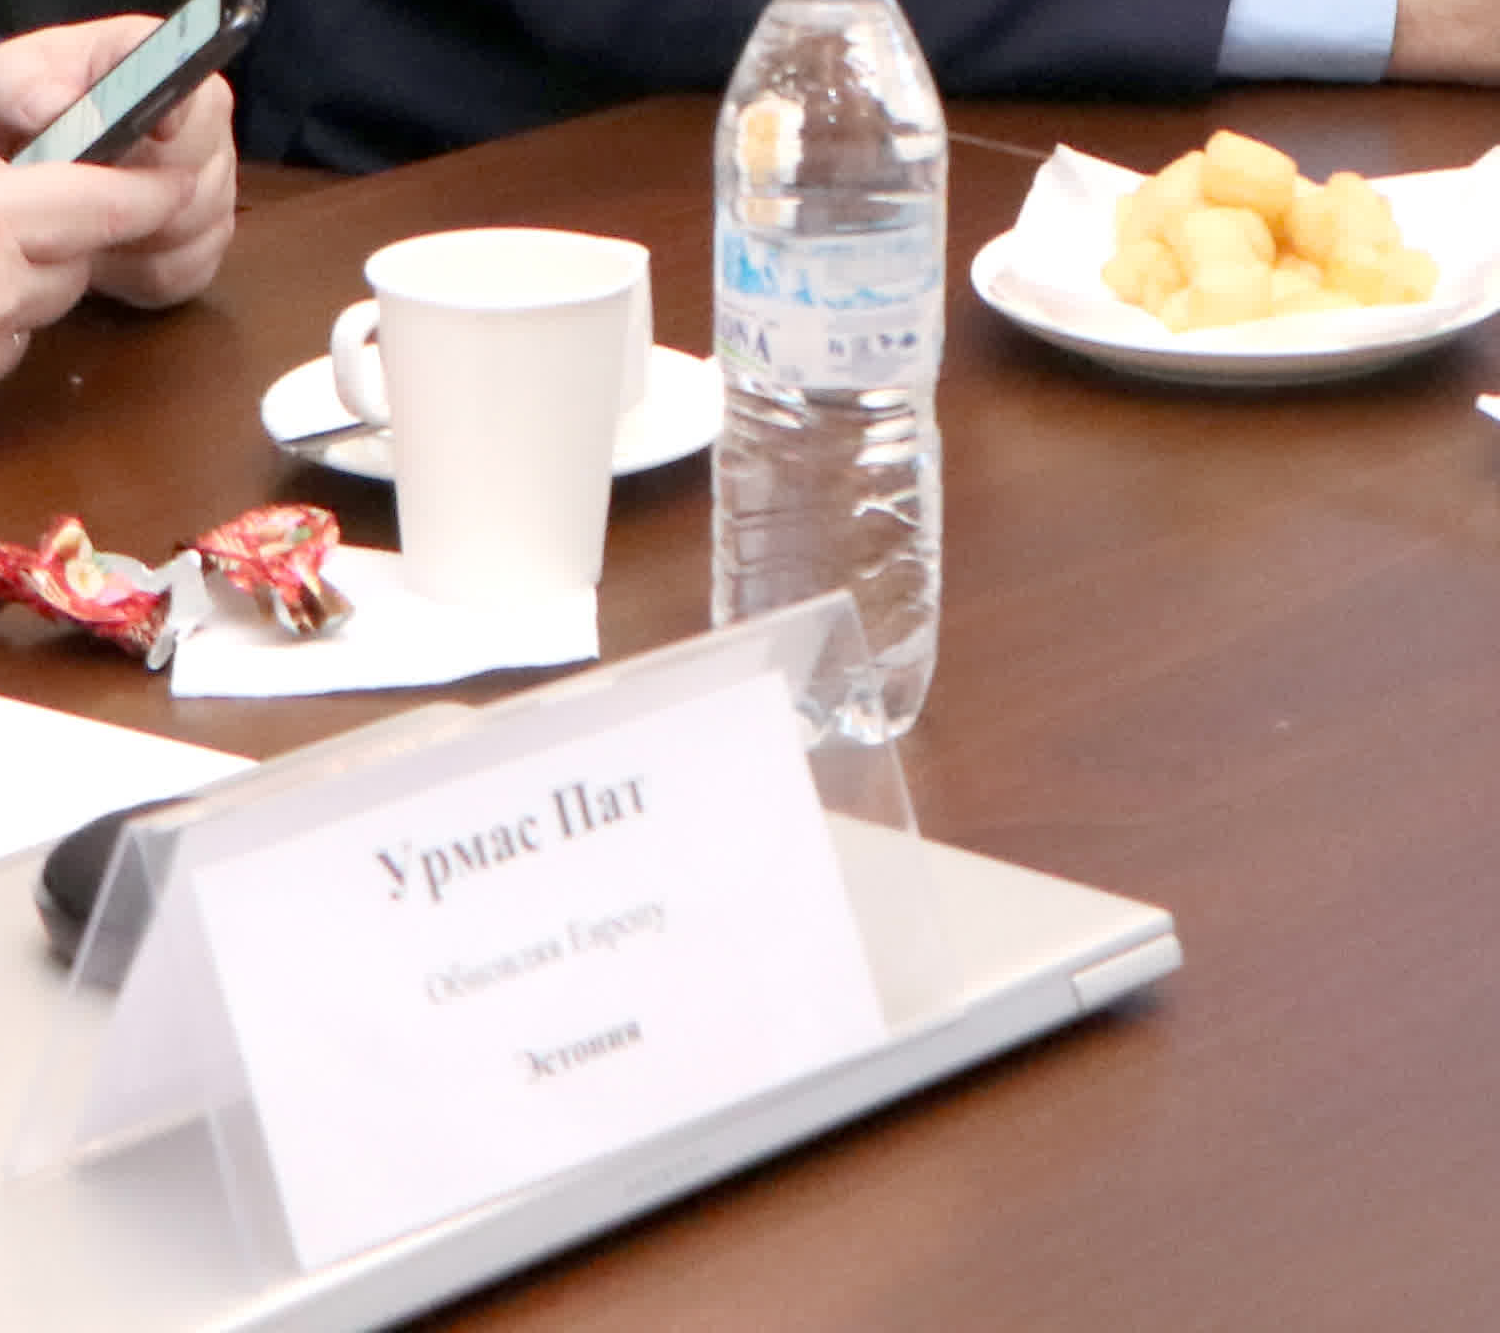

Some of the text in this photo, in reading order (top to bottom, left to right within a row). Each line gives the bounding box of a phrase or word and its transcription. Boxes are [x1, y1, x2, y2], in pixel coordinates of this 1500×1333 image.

[375, 778, 647, 904] Урмас Пат
[514, 1020, 643, 1084] Эстония
